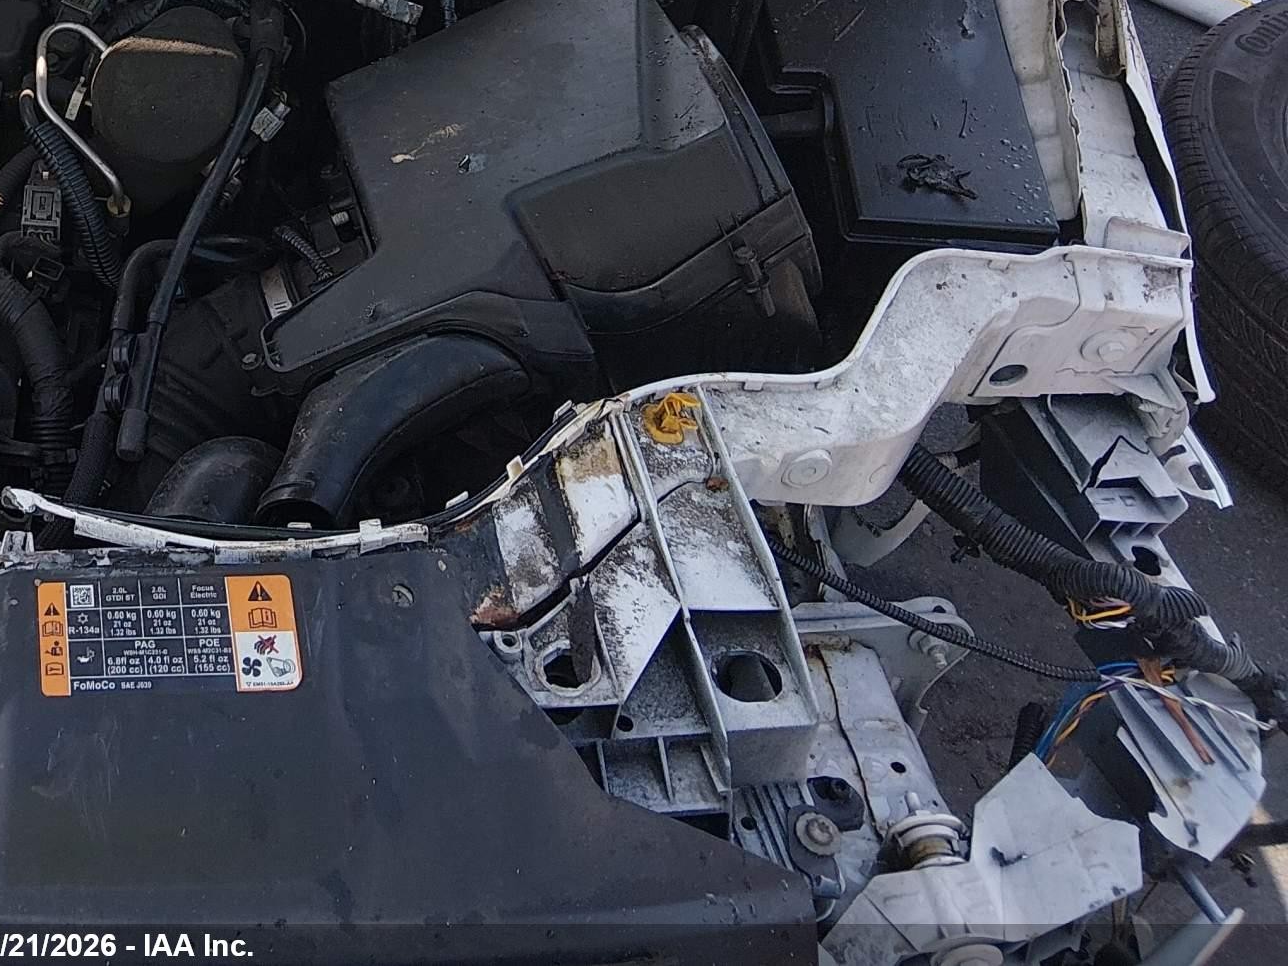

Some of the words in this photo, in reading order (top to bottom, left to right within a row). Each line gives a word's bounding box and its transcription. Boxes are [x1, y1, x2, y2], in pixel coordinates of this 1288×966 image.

[192, 584, 214, 592] Focus
[107, 612, 124, 620] 0.60
[126, 611, 136, 621] kg
[147, 610, 164, 618] 0.60
[166, 610, 176, 619] kg
[191, 609, 209, 617] 0.60
[210, 608, 221, 619] kg
[69, 626, 100, 634] R-134a
[134, 640, 156, 649] PAG
[199, 639, 220, 647] POE
[193, 655, 207, 663] 5.2
[108, 665, 127, 675] (200
[129, 665, 143, 674] cc)
[149, 665, 168, 674] (120
[170, 664, 185, 674] cc)
[195, 664, 214, 673] (155
[216, 663, 231, 672] cc)
[73, 681, 115, 691] FoMoCo
